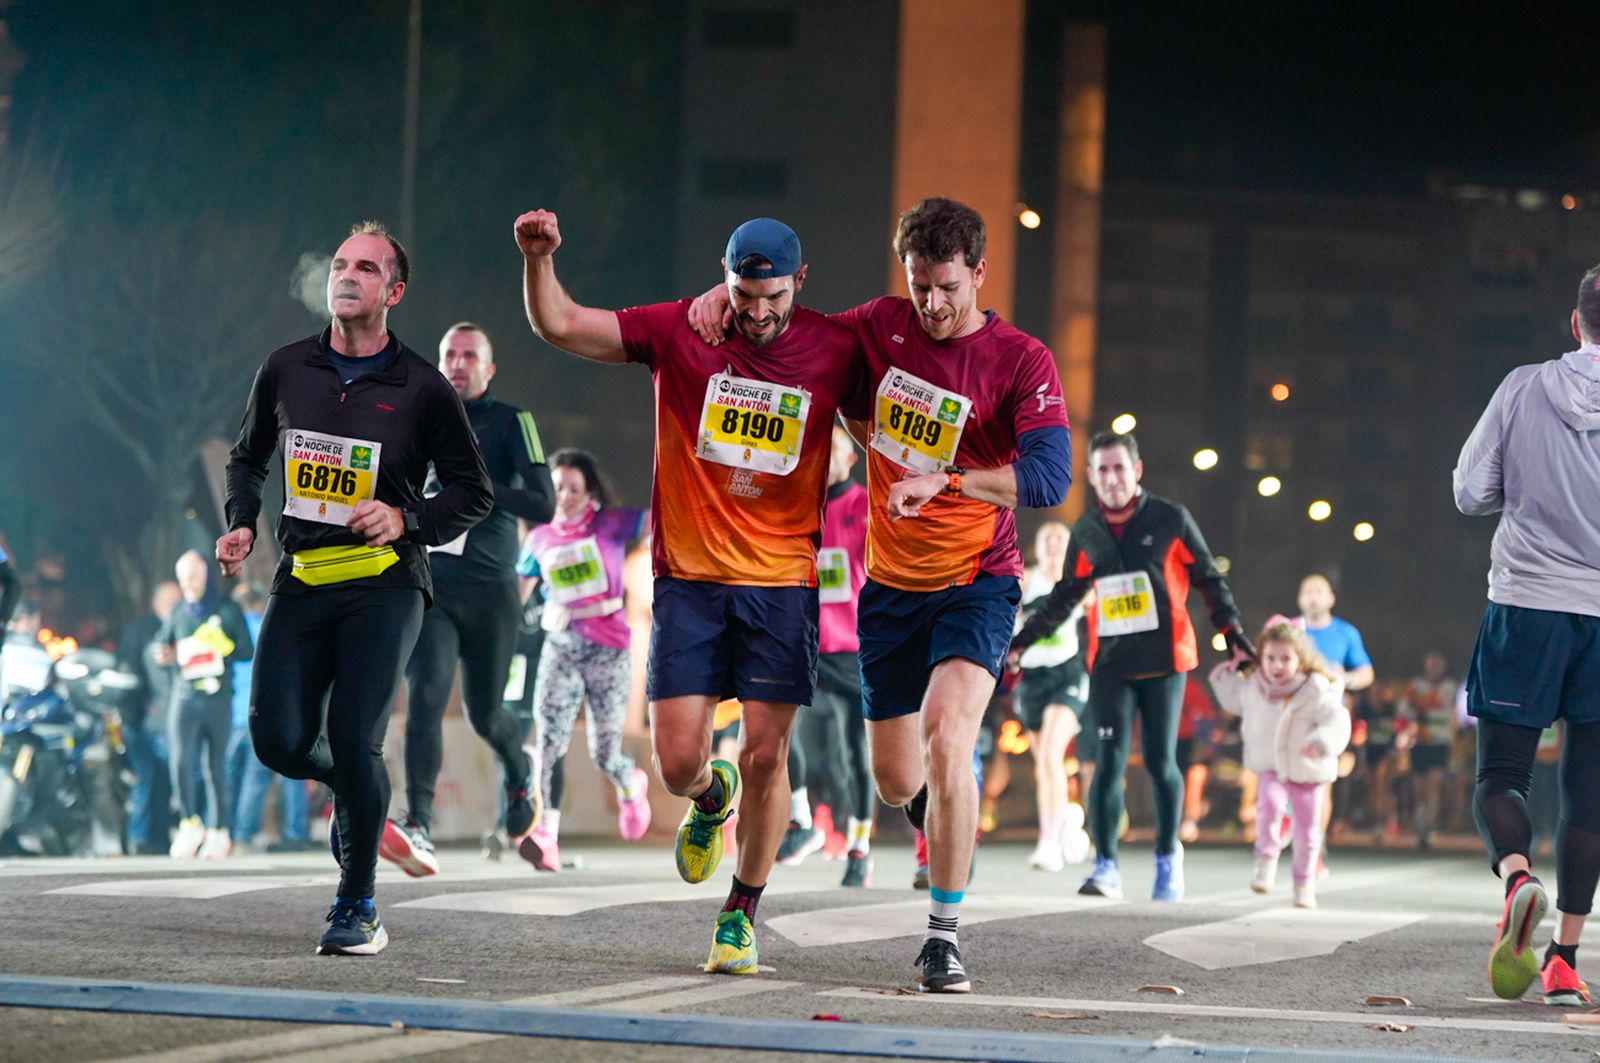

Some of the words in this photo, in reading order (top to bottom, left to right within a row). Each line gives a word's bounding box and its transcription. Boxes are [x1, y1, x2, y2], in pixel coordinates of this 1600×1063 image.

[730, 386, 760, 400] NOCHE
[760, 391, 773, 402] DE
[886, 389, 903, 402] SAN
[903, 396, 932, 415] ANTÓN
[899, 382, 925, 401] NOCHE
[924, 392, 934, 405] DE
[716, 394, 737, 406] SAN
[738, 399, 771, 413] ANTÓN
[721, 408, 785, 443] 8190
[889, 404, 942, 447] 8189
[303, 440, 332, 454] NOCHE
[332, 445, 344, 456] DE
[292, 449, 311, 461] SAN
[312, 453, 342, 467] ANTÓN
[297, 462, 357, 497] 6876
[731, 473, 753, 485] SAN
[299, 490, 326, 501] ANTONIO
[326, 494, 349, 505] MIGUEL
